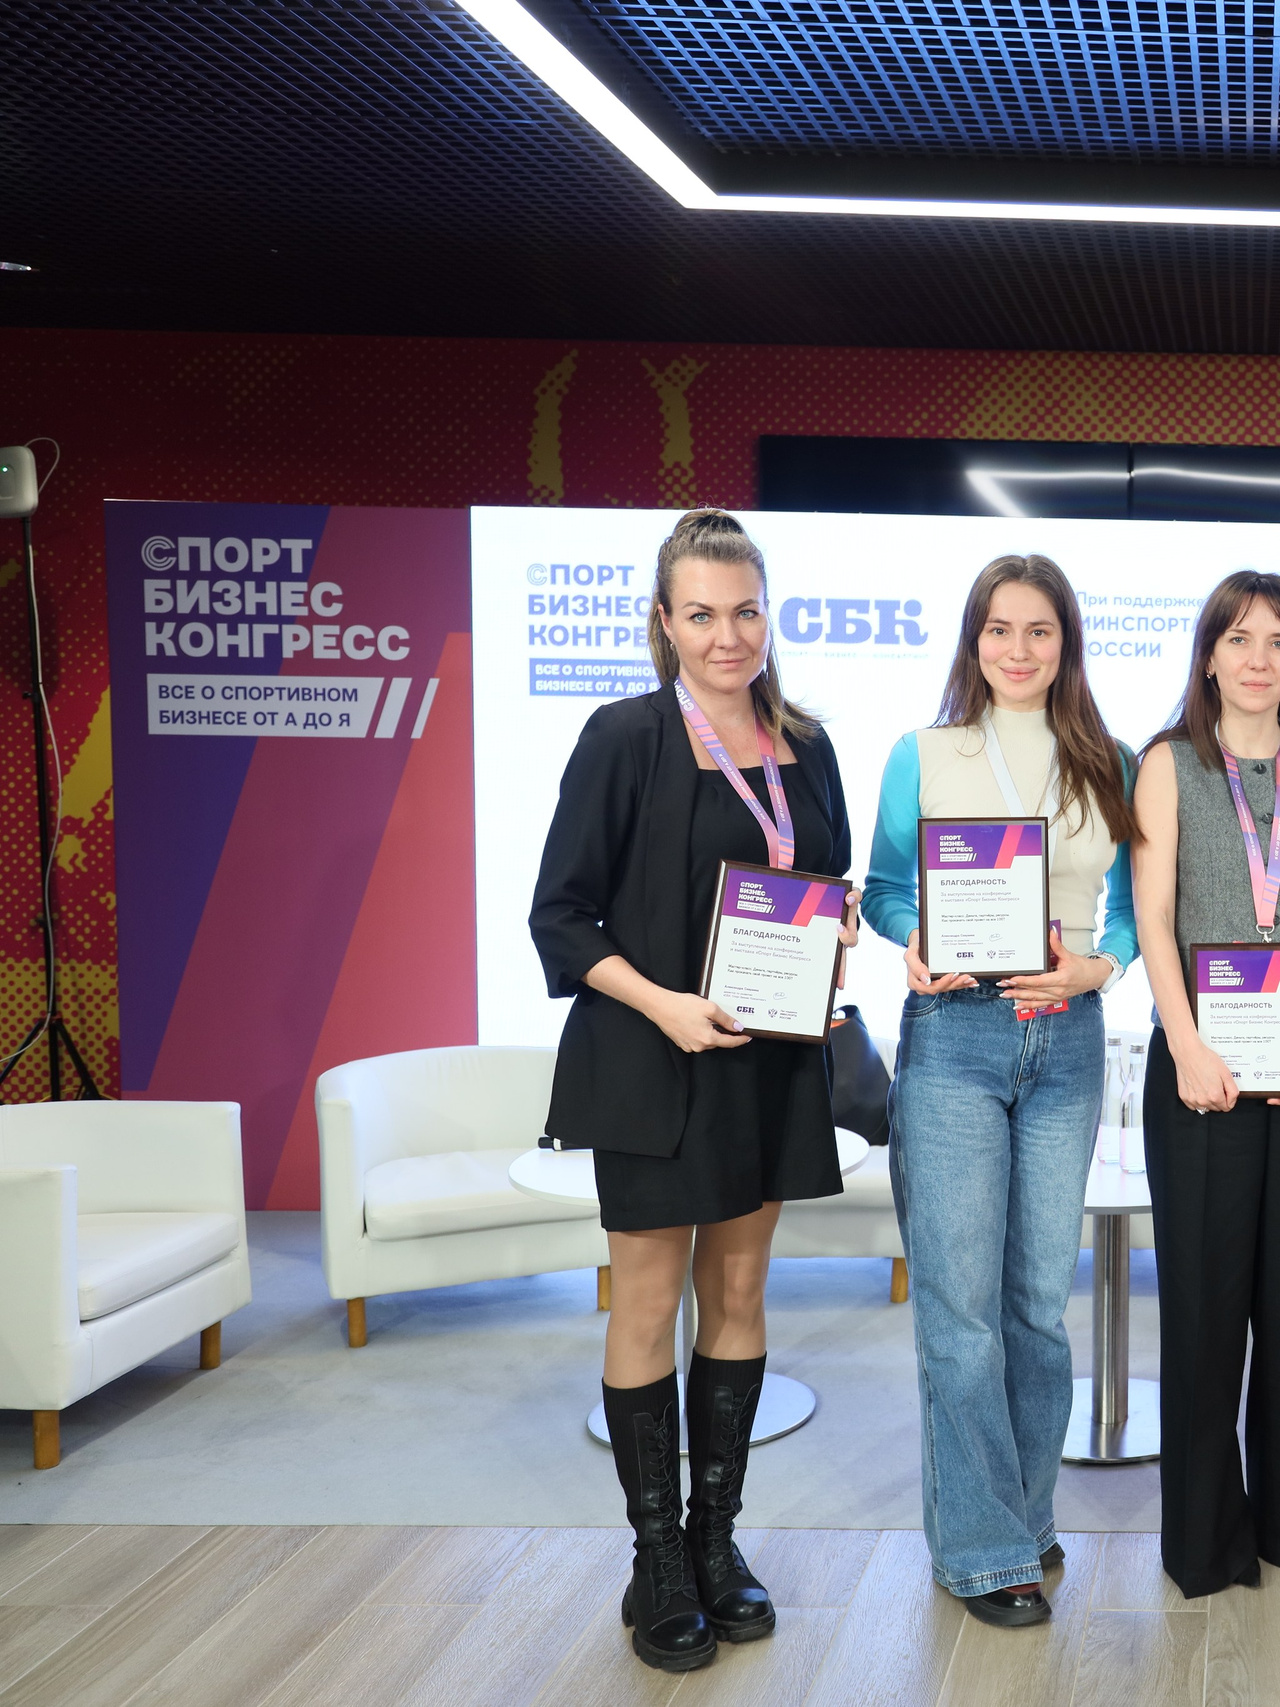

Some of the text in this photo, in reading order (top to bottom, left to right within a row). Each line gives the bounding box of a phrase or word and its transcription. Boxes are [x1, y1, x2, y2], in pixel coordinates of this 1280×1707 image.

[142, 536, 312, 573] СПОРТ
[527, 563, 634, 586] СПОРТ
[144, 579, 343, 617] БИЗНЕС
[1076, 591, 1107, 607] При
[779, 597, 928, 646] СБК
[1082, 616, 1197, 633] МИНСПОРТ
[145, 622, 410, 660] КОНГРЕСС
[529, 625, 648, 647] КОНГРЕ
[1089, 641, 1161, 658] ОССИИ
[535, 664, 658, 676] ВСЕ О СПОРТИВНО
[158, 685, 358, 702] ВСЕ О СПОРТИВНОМ
[536, 680, 592, 692] БИЗНЕСЕ
[595, 681, 612, 692] ОТ
[614, 682, 624, 693] А
[626, 682, 646, 694] ДО
[159, 710, 350, 729] БИЗНЕСЕ ОТ А ДО Я
[940, 879, 1007, 887] БЛАГОДАРНОСТЬ
[739, 894, 773, 903] КОНГРЕСС
[740, 888, 766, 896] БИЗНЕС
[733, 928, 801, 943] БЛАГОДАРНОСТЬ
[736, 1006, 755, 1014] СБК
